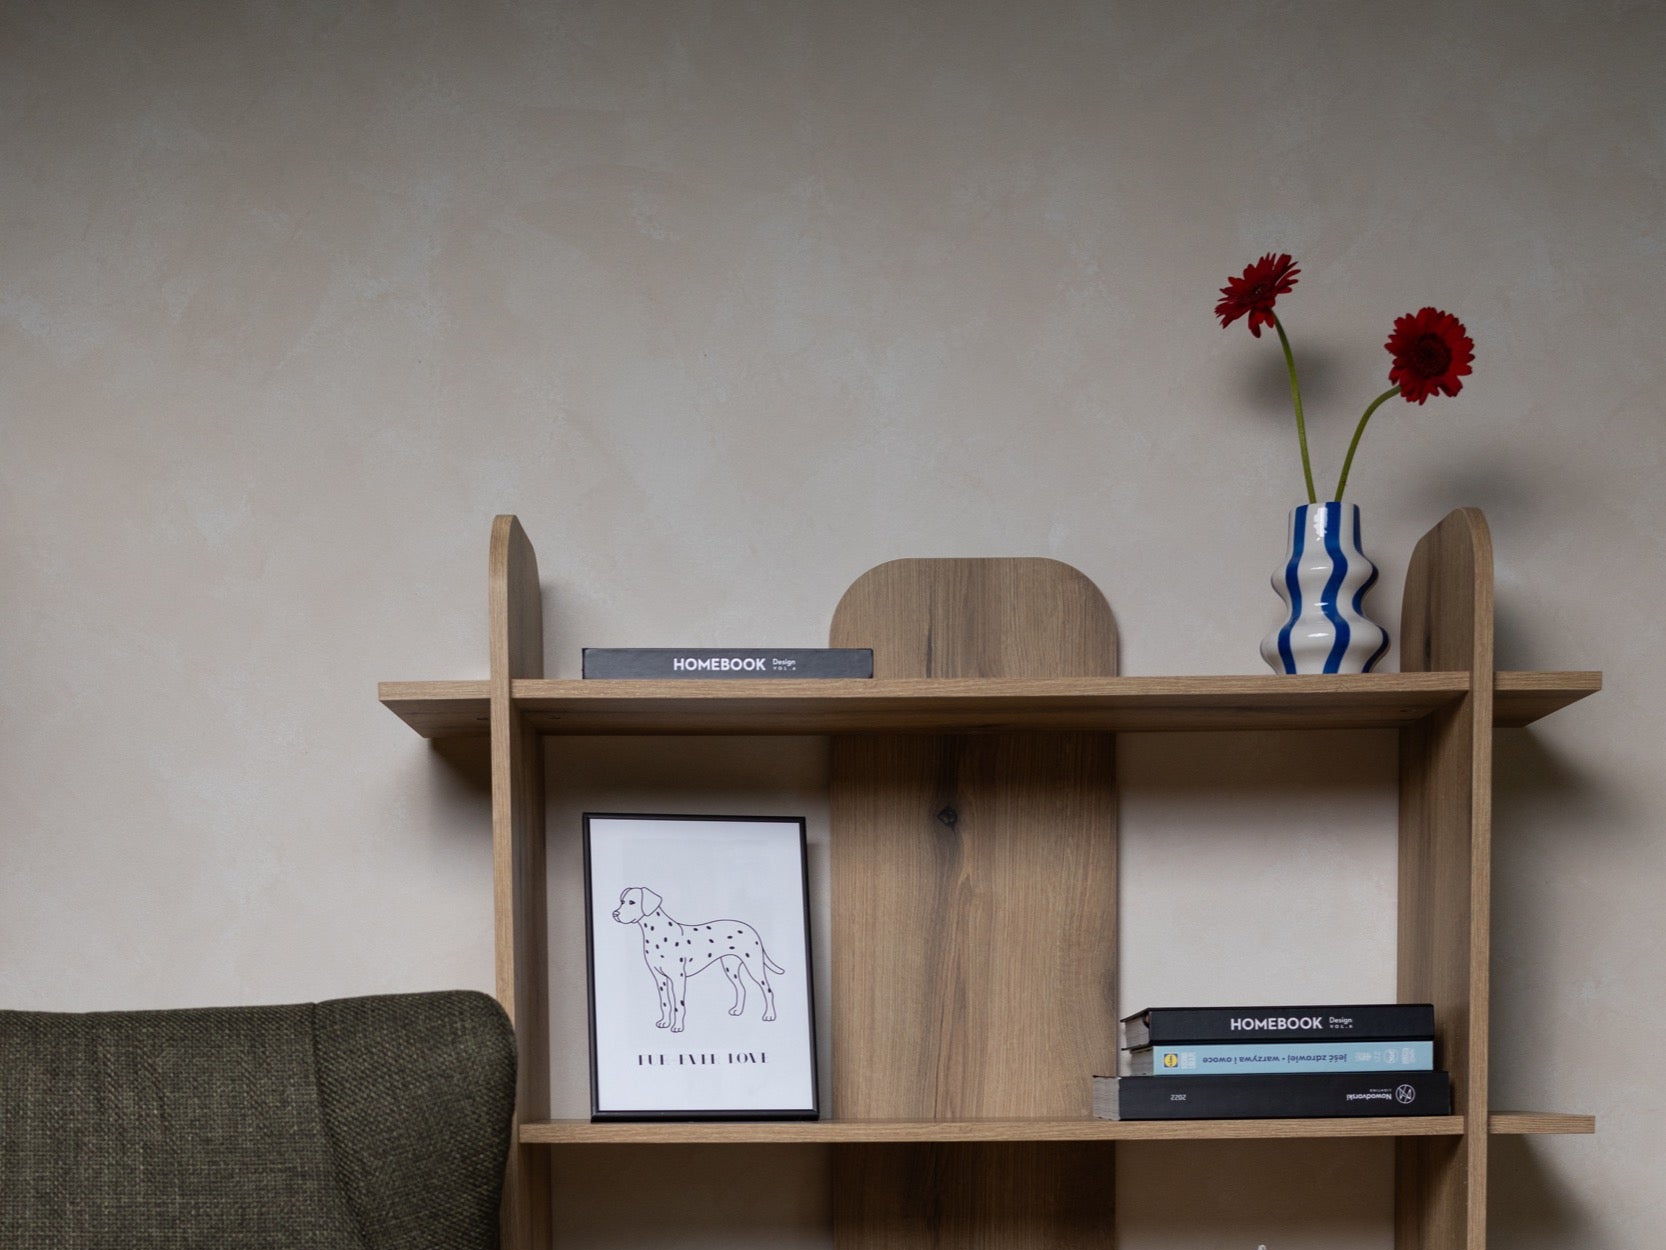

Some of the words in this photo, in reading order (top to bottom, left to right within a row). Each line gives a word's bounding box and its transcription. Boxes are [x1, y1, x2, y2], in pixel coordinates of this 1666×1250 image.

[673, 658, 766, 671] HOMEBOOK
[772, 658, 796, 667] Design
[1230, 1016, 1323, 1031] HOMEBOOK
[1329, 1016, 1353, 1025] Design
[1239, 1054, 1280, 1063] warzywa
[1287, 1054, 1327, 1064] zdrowiej
